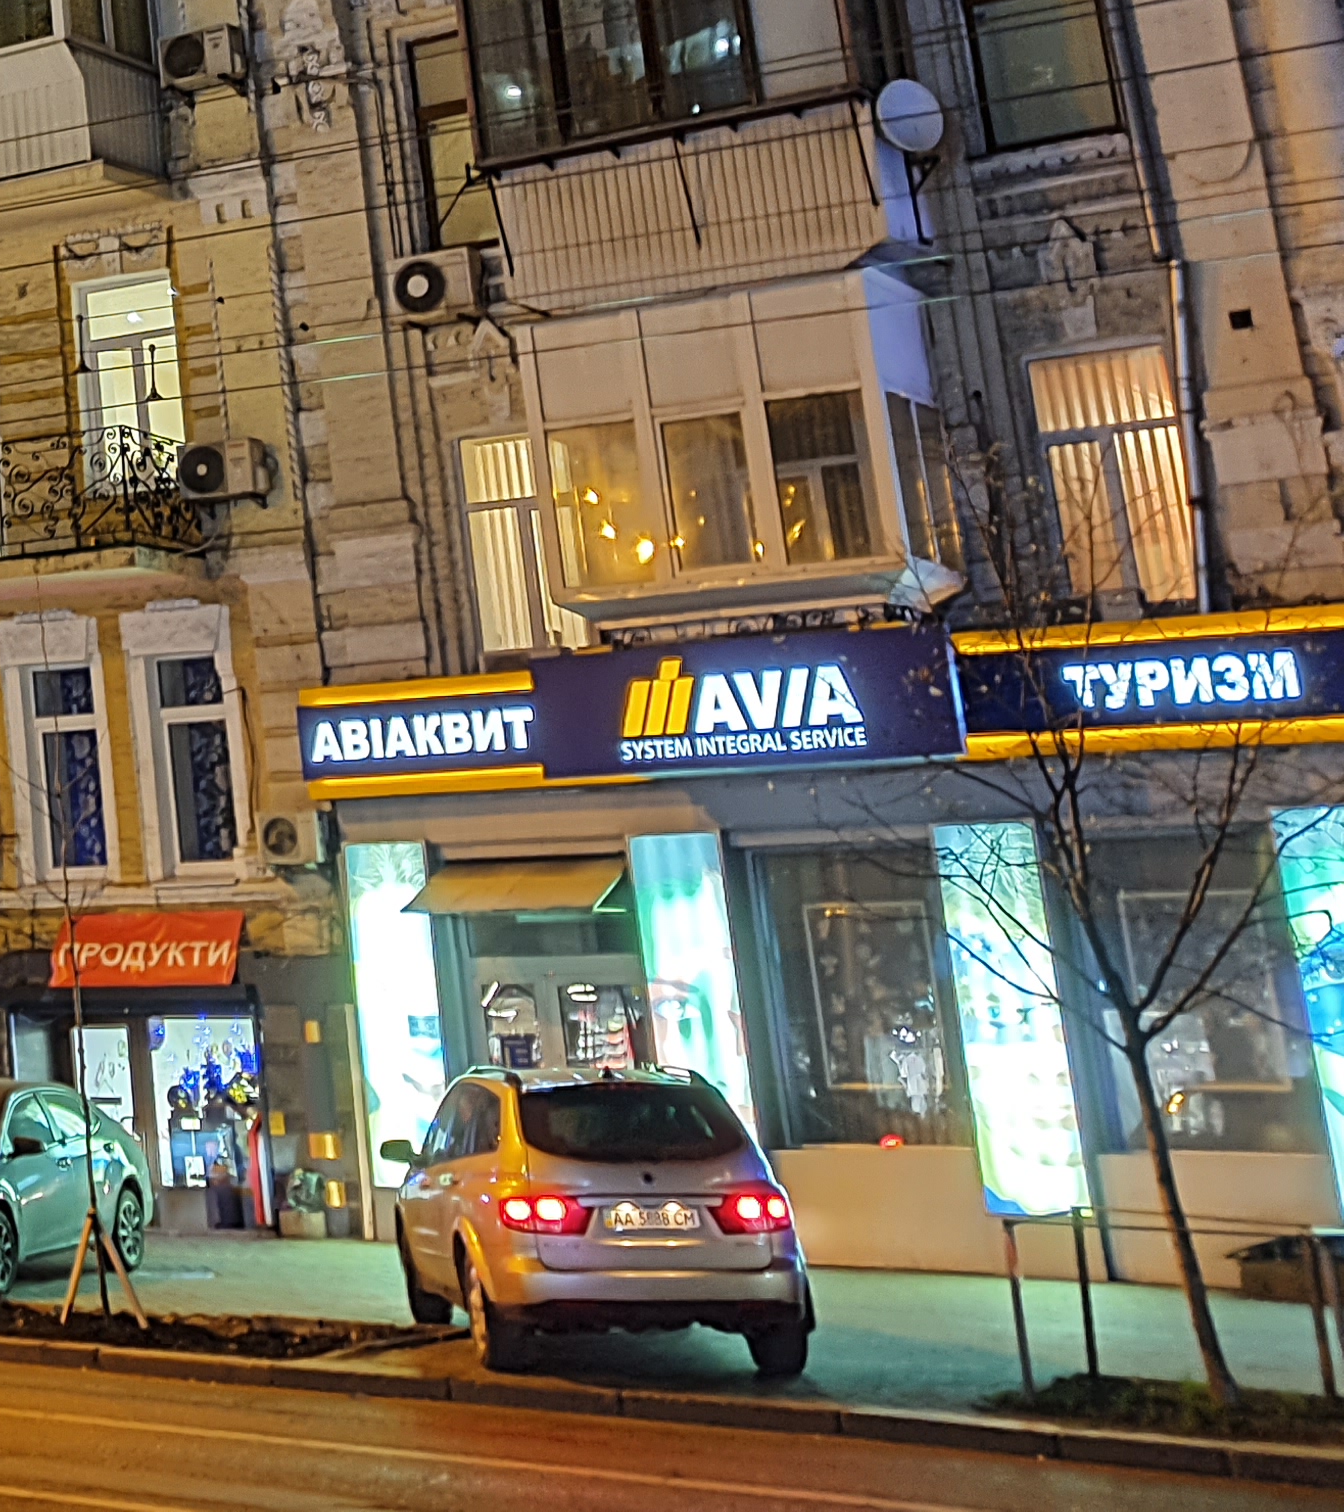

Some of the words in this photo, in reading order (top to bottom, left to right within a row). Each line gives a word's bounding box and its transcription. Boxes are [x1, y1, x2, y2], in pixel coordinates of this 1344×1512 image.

[694, 665, 864, 734] AVIA
[1062, 649, 1302, 709] ТУРИЗМ
[311, 705, 534, 763] АВІАКВИТ
[620, 737, 693, 762] SYSTEM
[695, 731, 787, 757] INTEGRAL
[790, 726, 868, 751] SERVICE
[58, 939, 233, 973] ПРОДУКТИ
[614, 1212, 634, 1226] AA
[673, 1211, 696, 1226] CM
